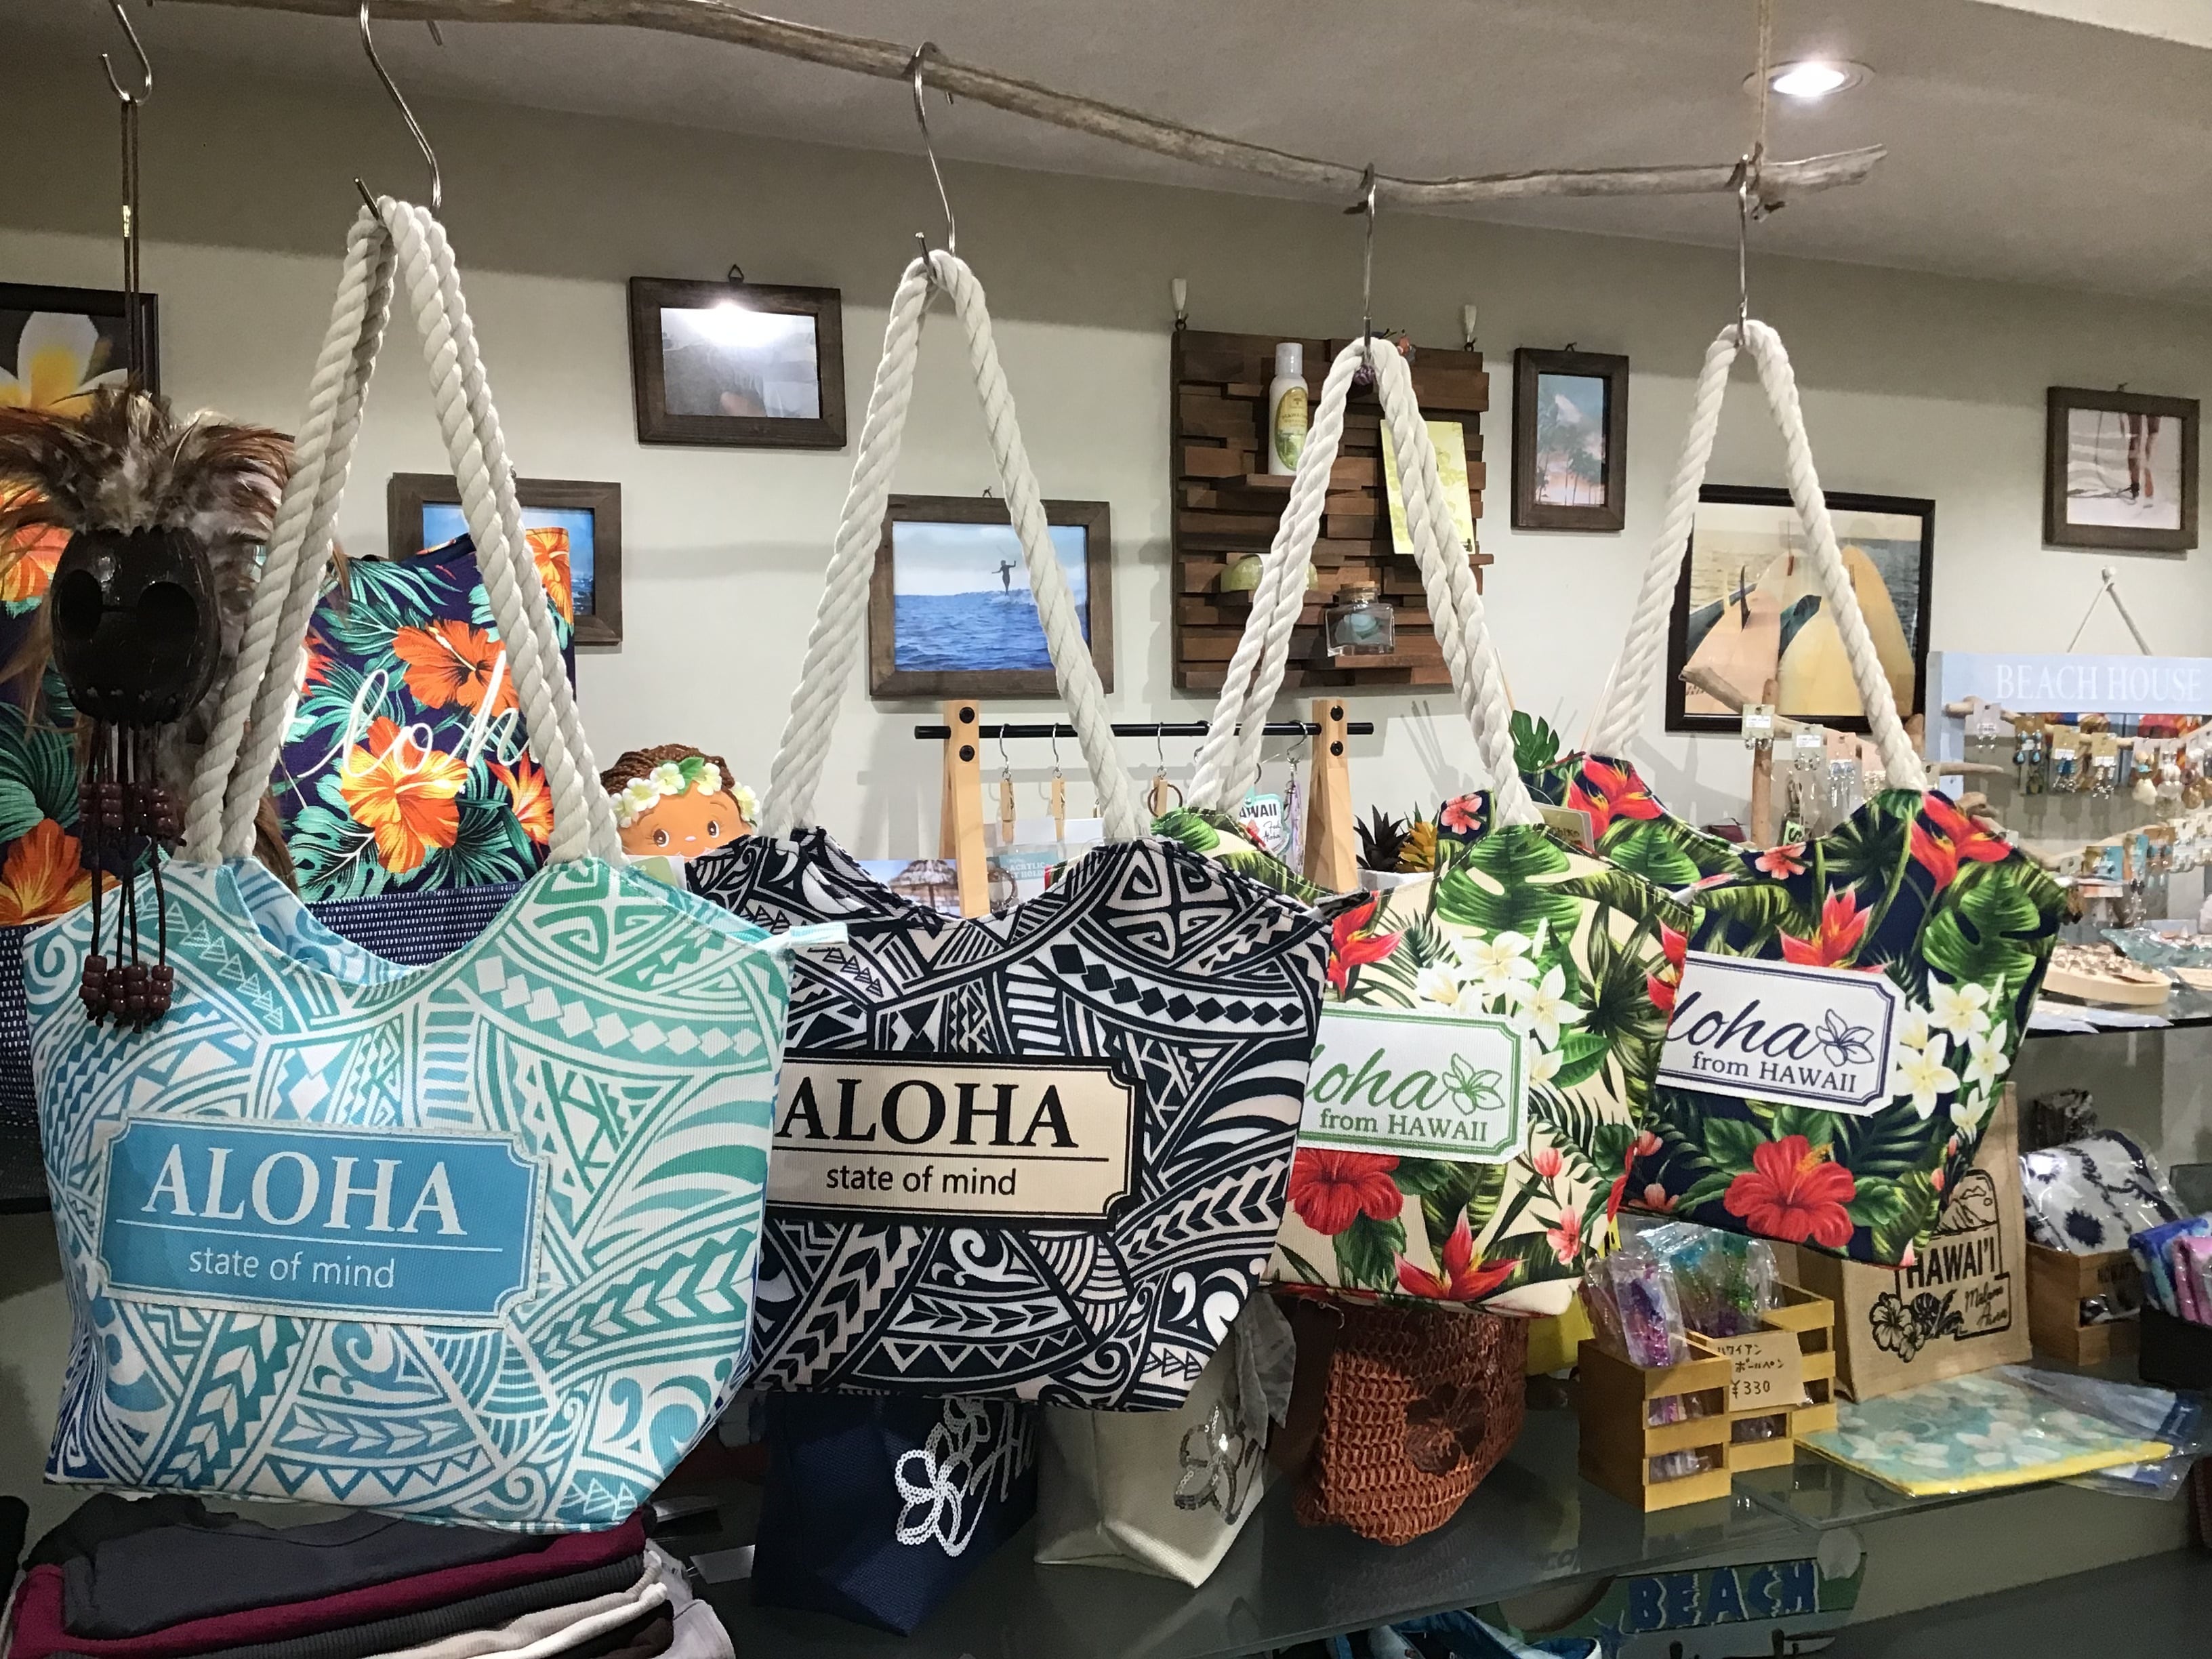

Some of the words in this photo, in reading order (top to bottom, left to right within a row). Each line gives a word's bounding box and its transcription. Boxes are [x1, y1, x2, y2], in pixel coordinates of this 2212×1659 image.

[1996, 664, 2098, 700] BEACH
[2108, 666, 2202, 702] HOUSE
[1239, 803, 1278, 819] AWAII
[1008, 861, 1046, 872] ACRYLIC
[1692, 1051, 1748, 1078] from
[1759, 1062, 1857, 1093] HAWAII
[775, 1076, 1079, 1148] ALOHA
[1319, 1108, 1378, 1133] from
[1387, 1114, 1488, 1142] HAWAII
[141, 1144, 468, 1235] ALOHA
[826, 1165, 893, 1191] state
[903, 1166, 934, 1193] of
[943, 1169, 1017, 1195] mind
[188, 1247, 259, 1278] state
[270, 1250, 303, 1282] of
[312, 1256, 395, 1288] mind
[1735, 1357, 1784, 1373] ボールペン
[1731, 1380, 1771, 1399] ¥330
[1626, 1560, 1820, 1633] BEACH
